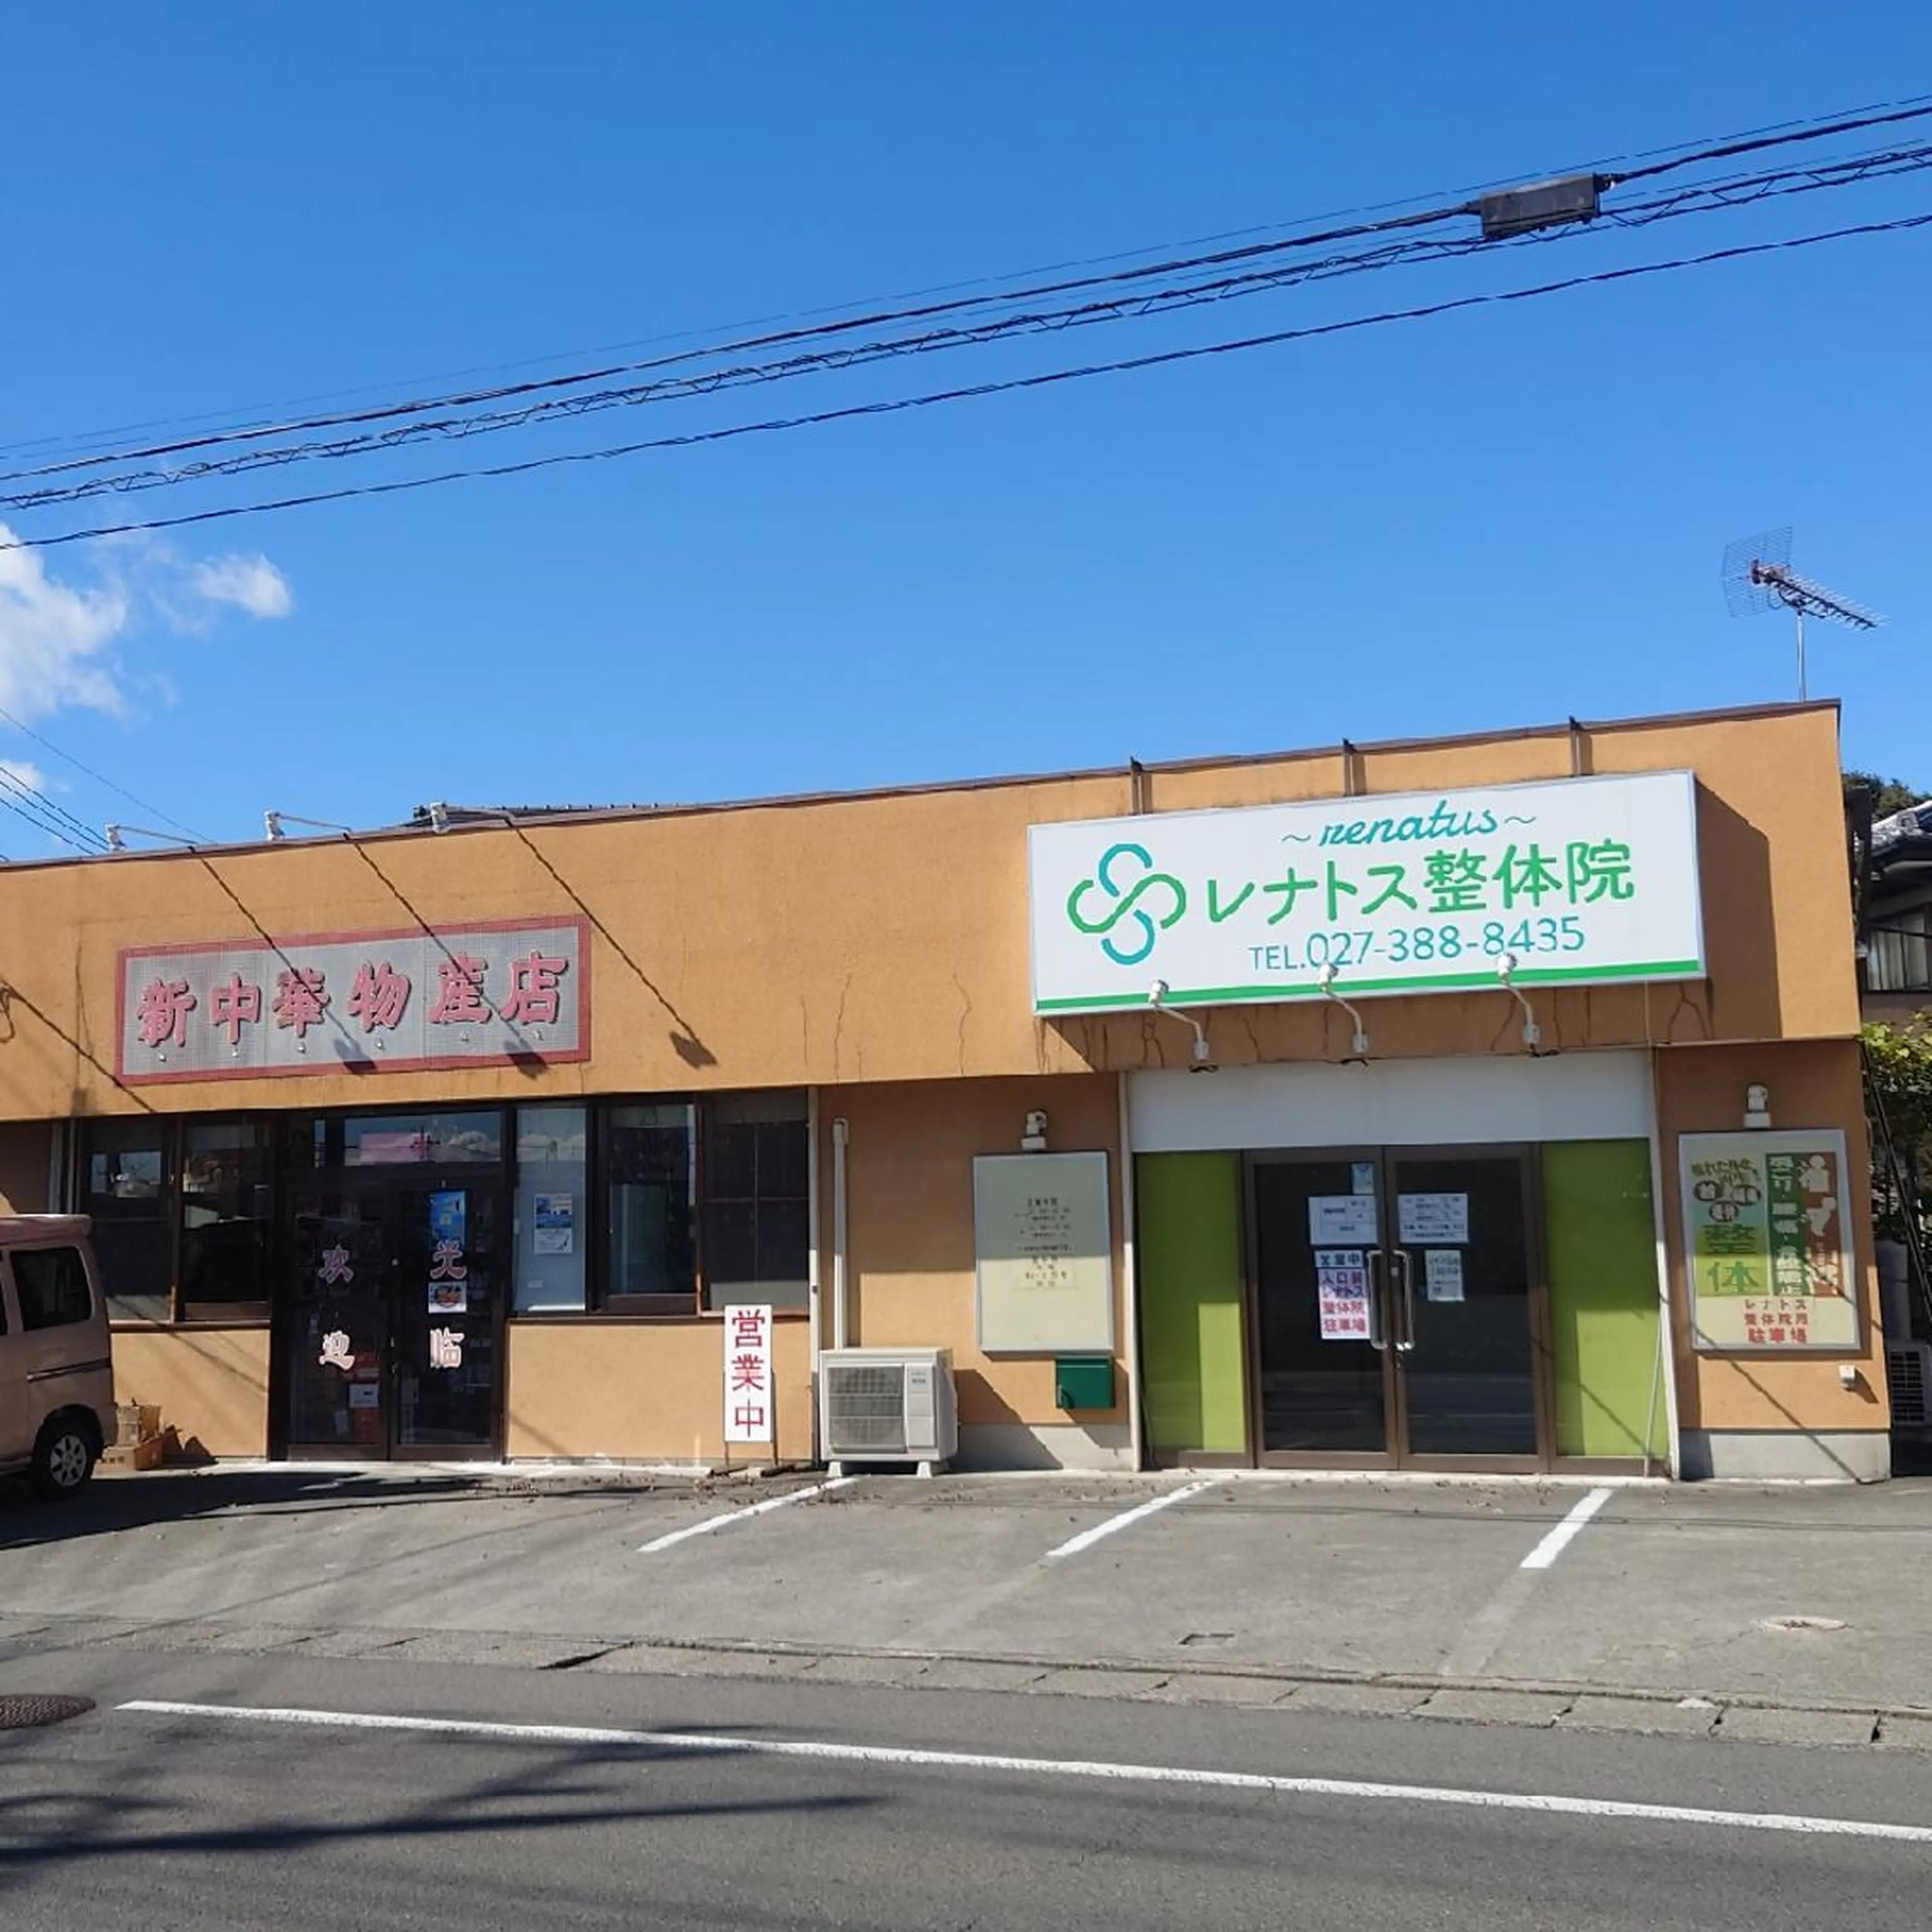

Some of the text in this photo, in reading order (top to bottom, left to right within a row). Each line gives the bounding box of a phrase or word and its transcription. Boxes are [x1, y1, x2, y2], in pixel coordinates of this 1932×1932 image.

[1208, 838, 1635, 925] レナトス整体院
[1702, 1224, 1759, 1293] 整体
[732, 1309, 765, 1437] 営業中
